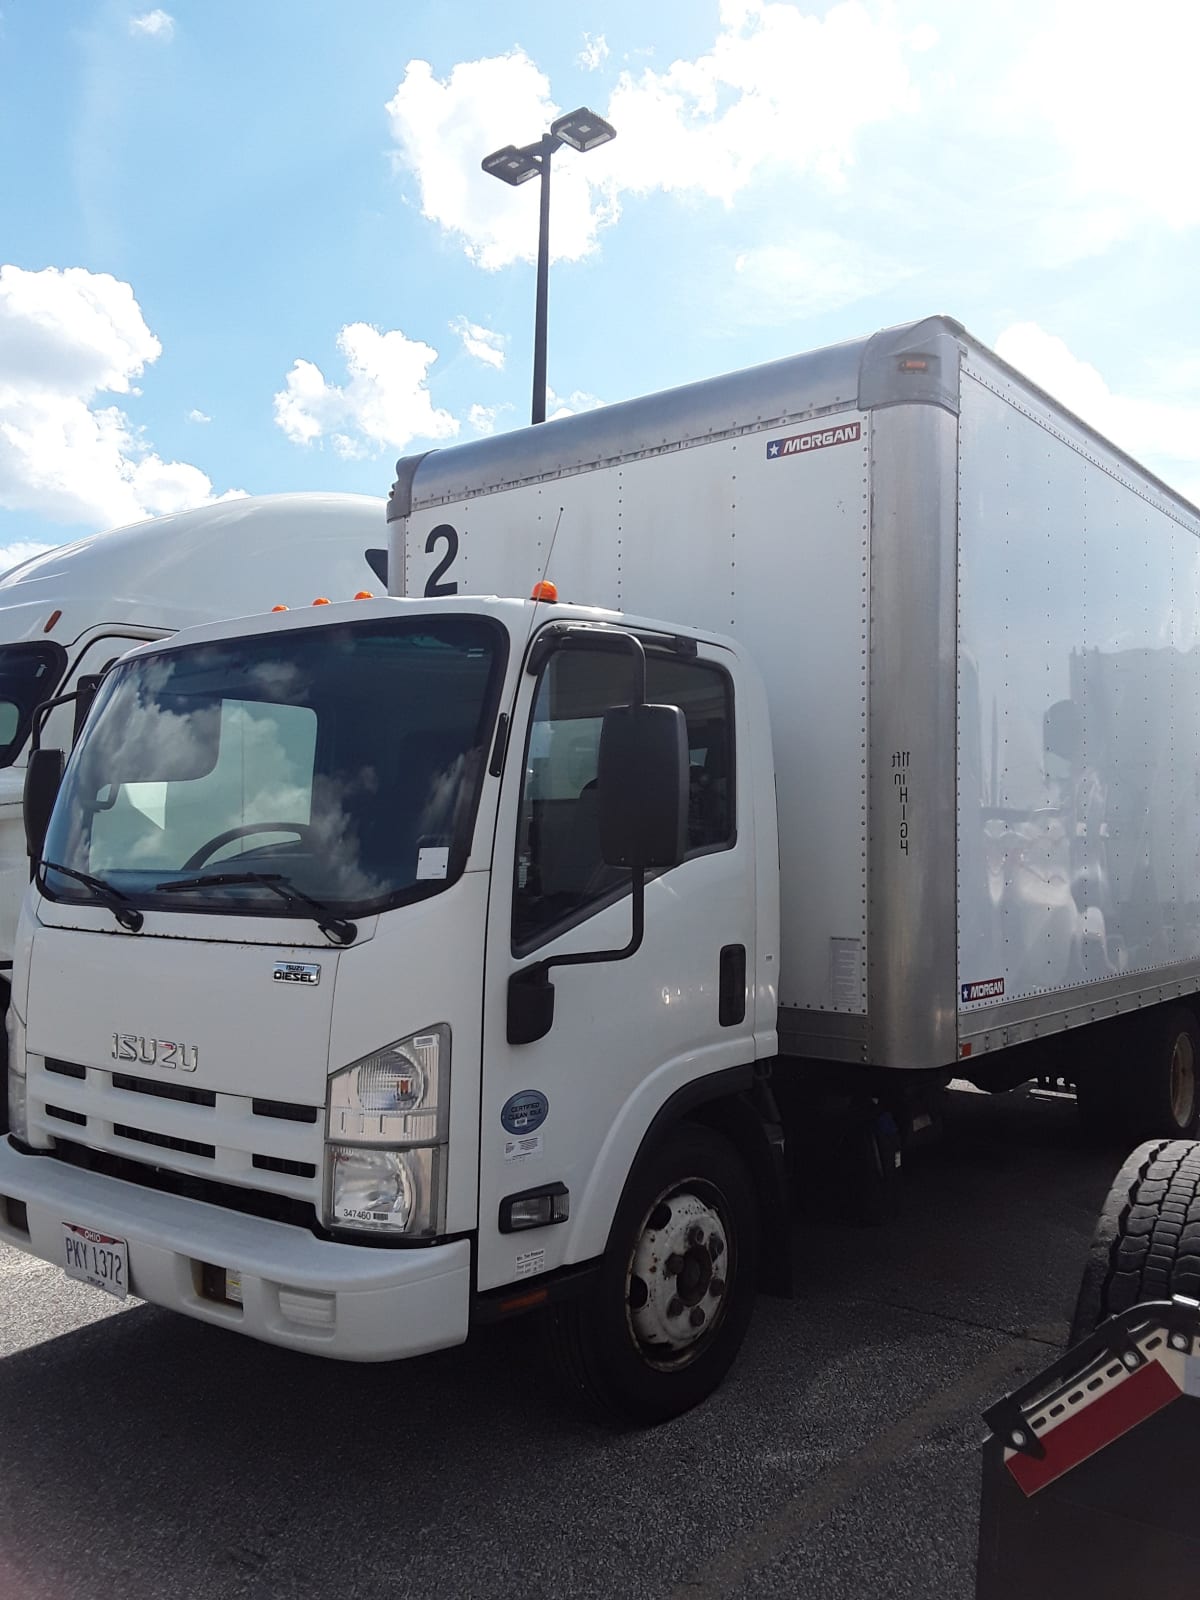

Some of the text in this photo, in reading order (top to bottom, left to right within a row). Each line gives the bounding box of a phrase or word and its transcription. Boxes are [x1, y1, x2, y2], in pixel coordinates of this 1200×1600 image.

[783, 426, 857, 454] MORGAN
[424, 524, 459, 598] 2
[274, 970, 315, 983] DIESEL
[970, 981, 1004, 999] MORGAN
[112, 1032, 198, 1072] ISUZU
[343, 1208, 372, 1221] 347460
[84, 1230, 101, 1242] OHIO
[66, 1237, 122, 1285] PKY 1372
